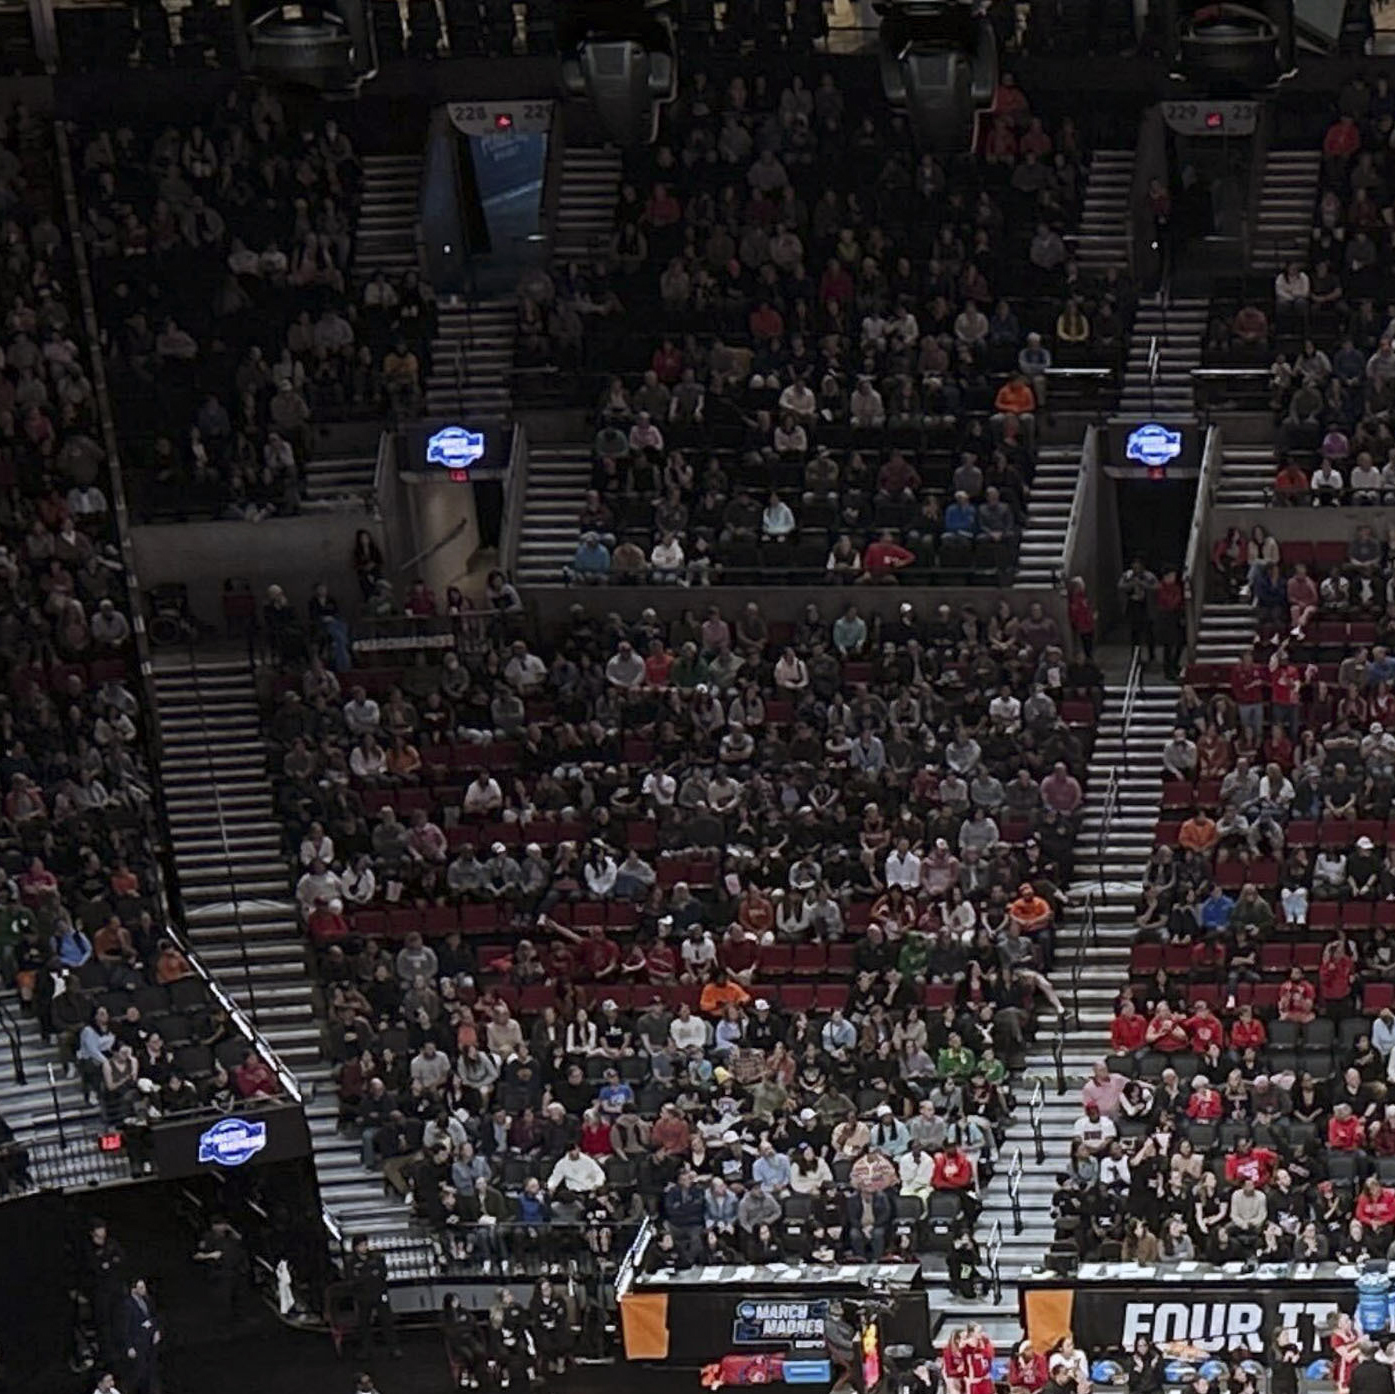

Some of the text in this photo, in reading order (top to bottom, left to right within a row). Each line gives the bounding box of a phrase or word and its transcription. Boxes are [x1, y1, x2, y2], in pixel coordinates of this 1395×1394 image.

[755, 1303, 808, 1320] MARCH
[762, 1318, 825, 1335] MADNES
[1122, 1302, 1265, 1353] FOUR
